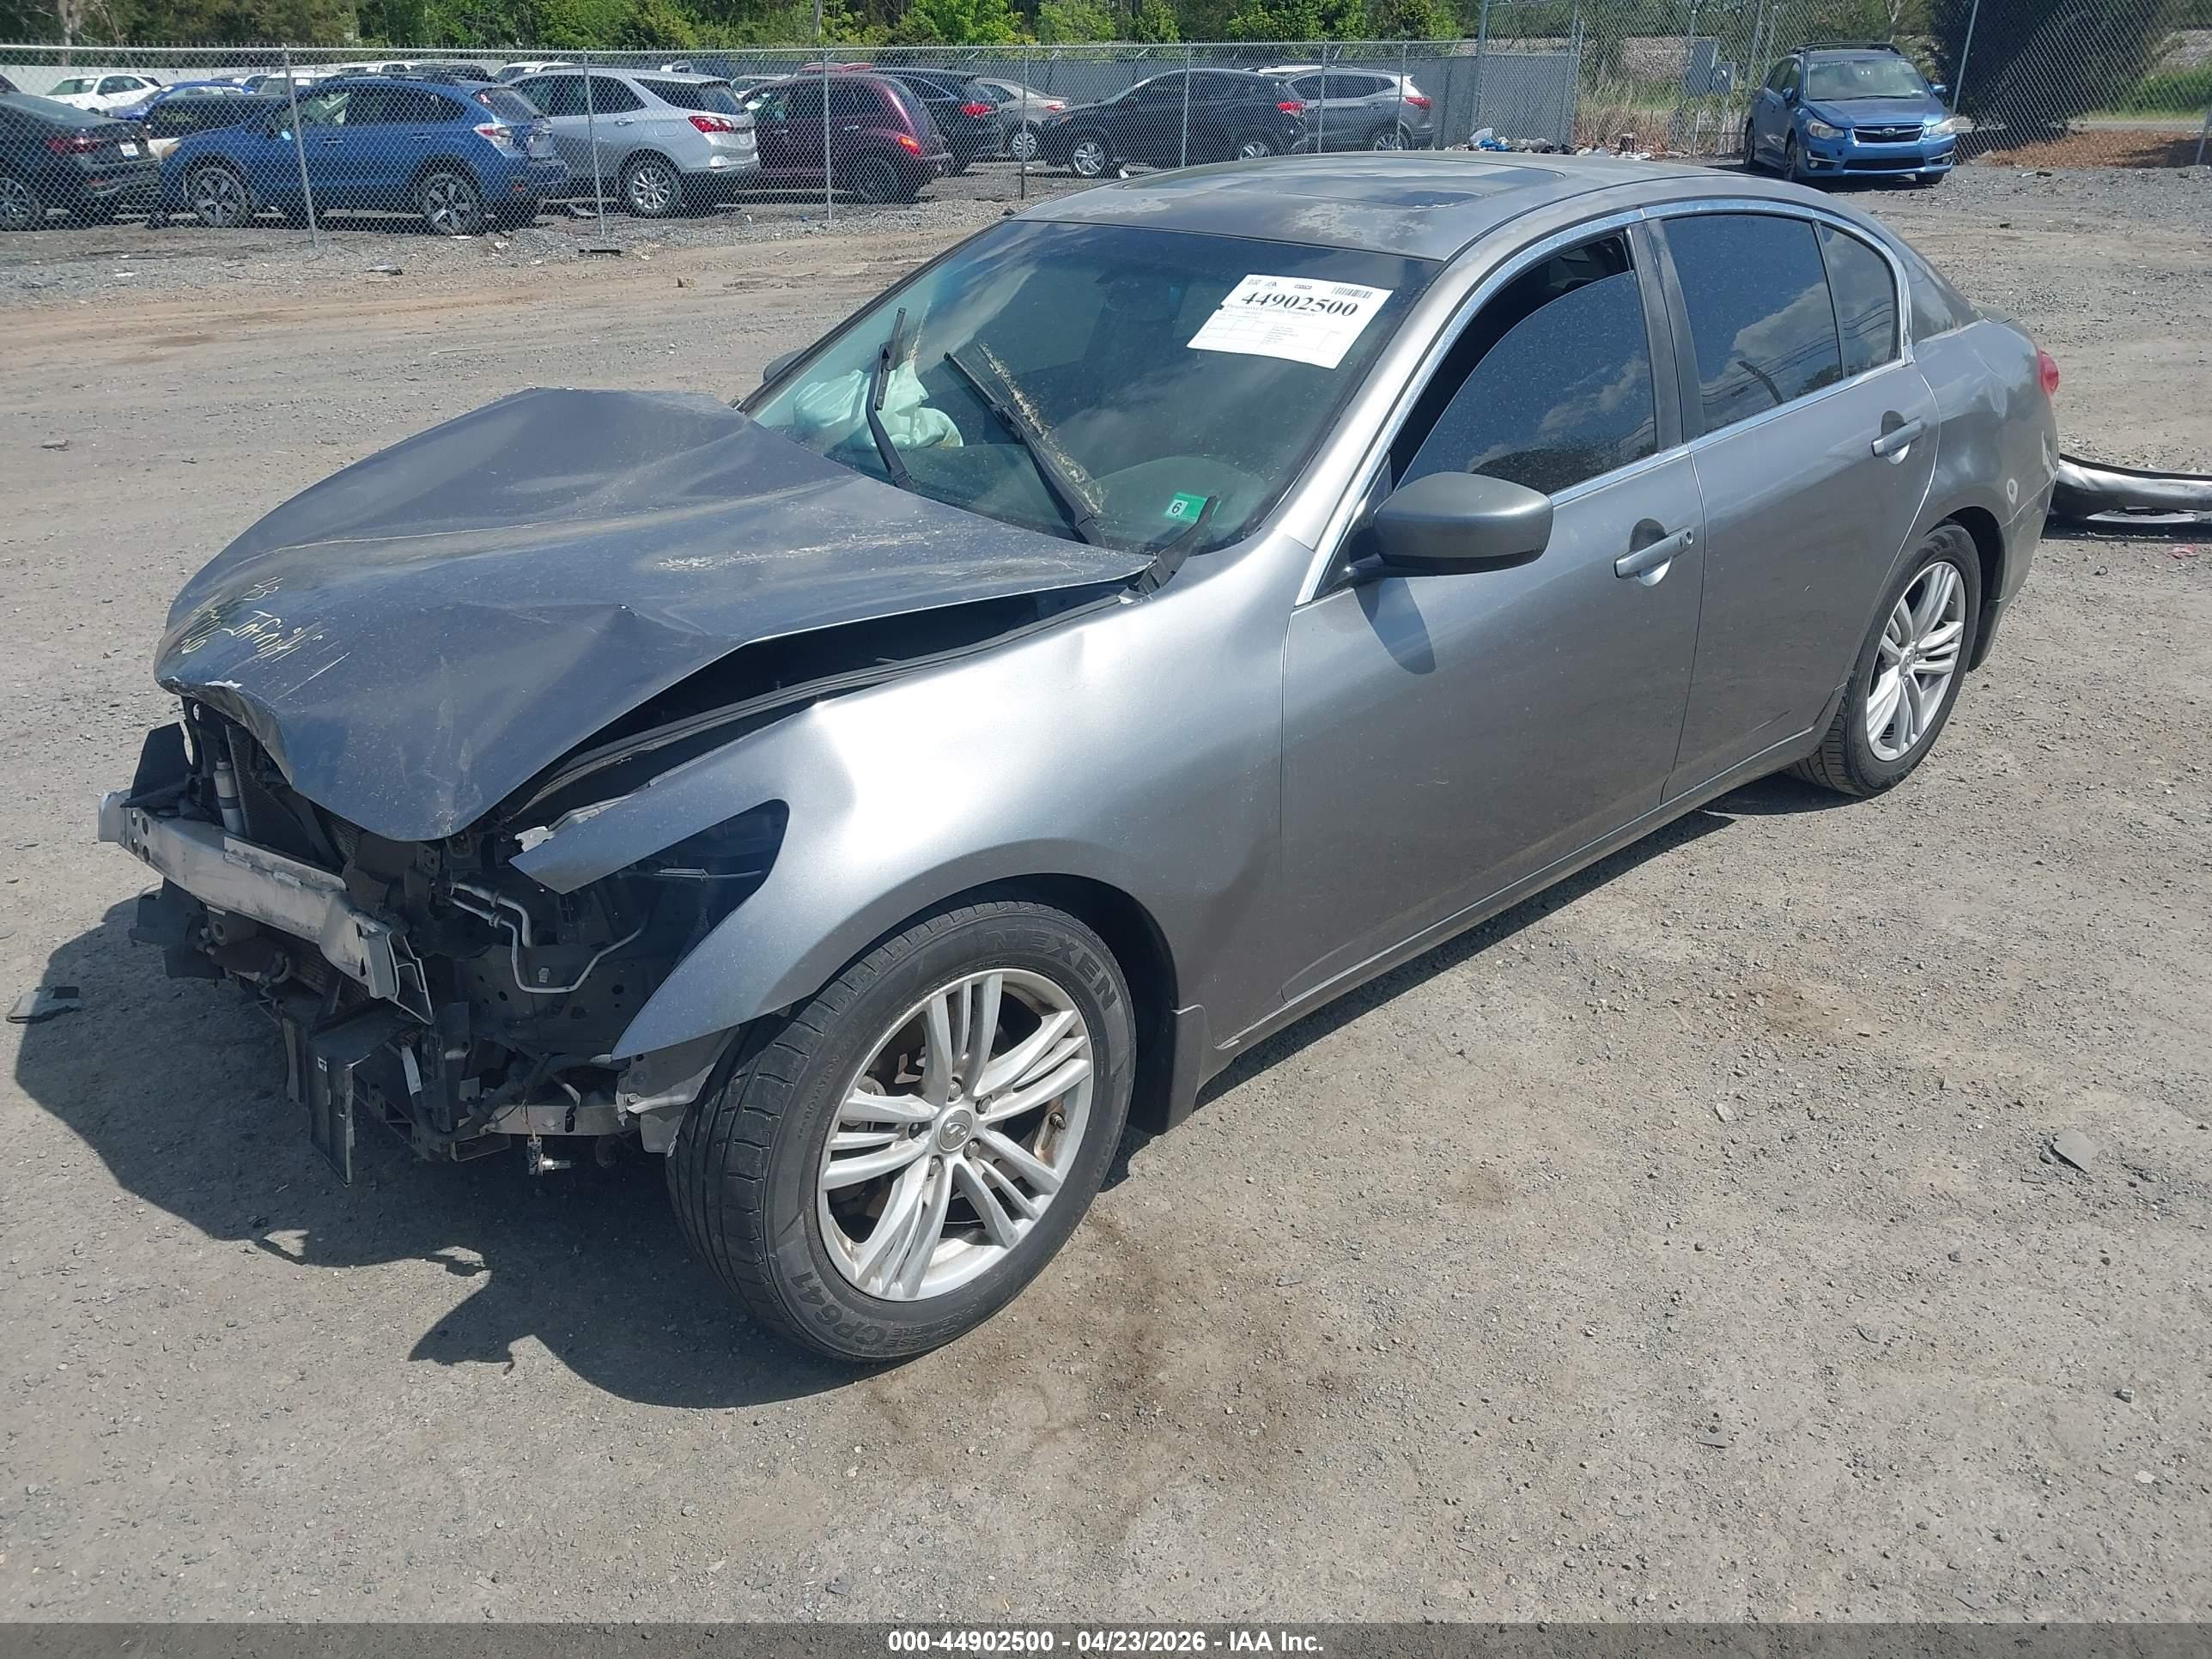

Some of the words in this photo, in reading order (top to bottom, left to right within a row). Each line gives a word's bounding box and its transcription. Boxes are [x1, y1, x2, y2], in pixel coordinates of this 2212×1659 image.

[1242, 292, 1358, 316] 44902500
[1171, 501, 1182, 514] 6
[986, 928, 1117, 1011] NEXEN
[790, 1271, 886, 1346] CP641
